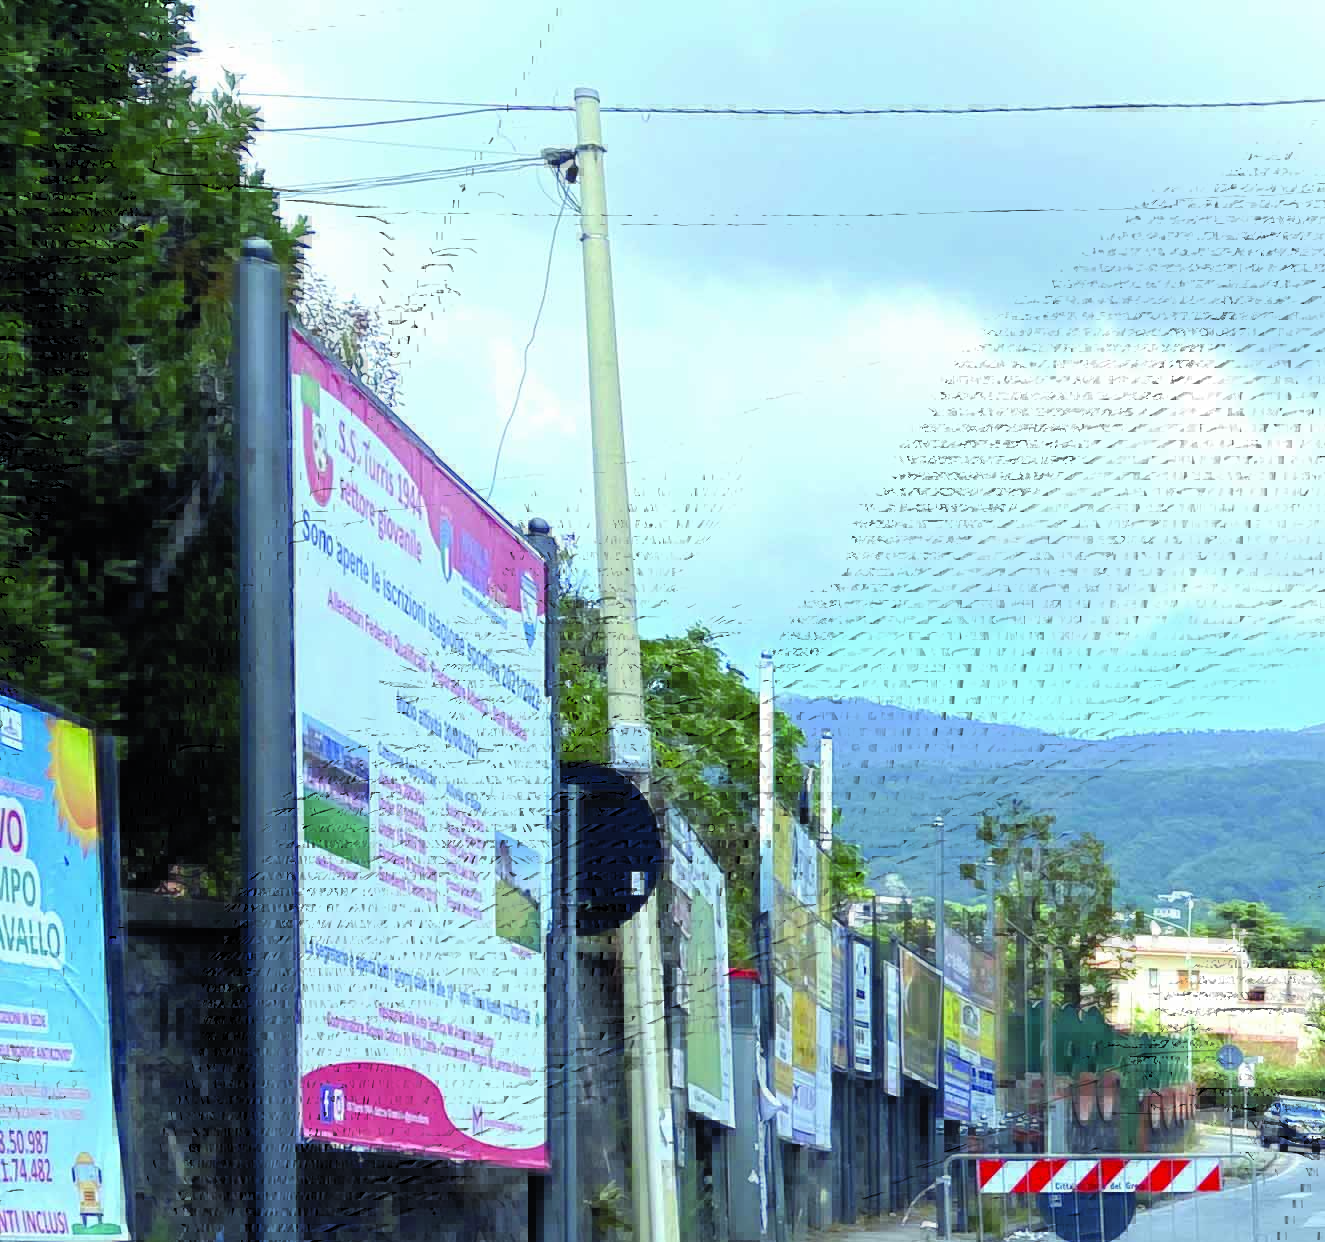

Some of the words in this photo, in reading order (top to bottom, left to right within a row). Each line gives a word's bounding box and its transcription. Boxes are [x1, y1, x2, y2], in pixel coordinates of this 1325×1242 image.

[363, 441, 394, 498] Turris
[398, 473, 423, 521] 1944
[378, 510, 423, 564] giovanile
[303, 509, 334, 557] Sono
[336, 541, 369, 585] aperte
[372, 562, 381, 593] le
[383, 570, 426, 628] iscrizioni
[428, 612, 465, 656] stagione
[467, 643, 500, 684] sportiva
[502, 664, 540, 712] 2021/2022
[22, 1209, 70, 1235] INCLUSI
